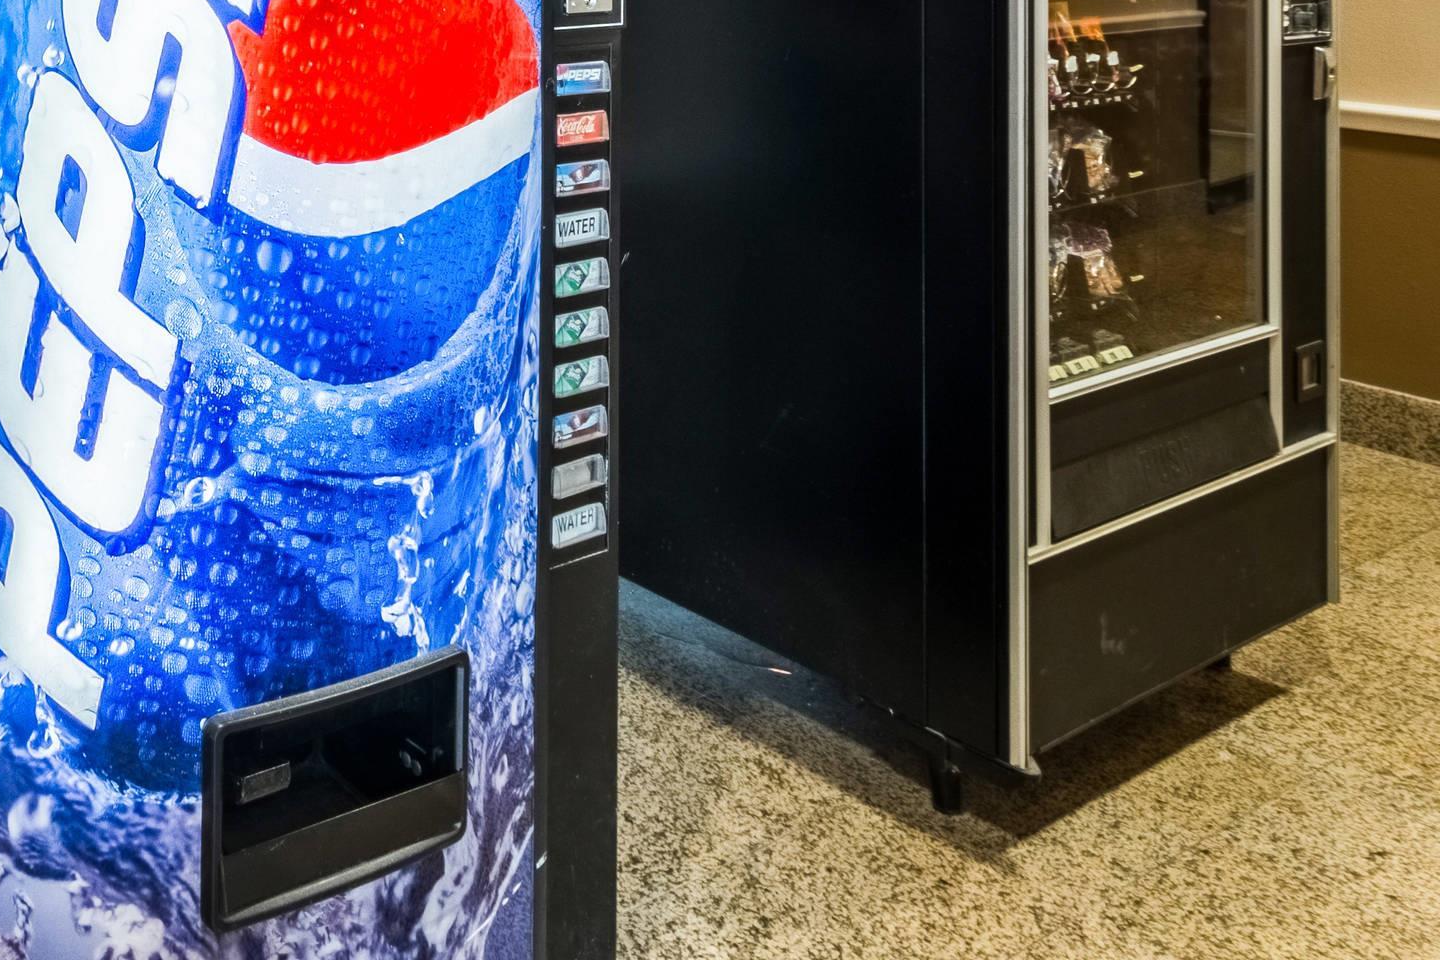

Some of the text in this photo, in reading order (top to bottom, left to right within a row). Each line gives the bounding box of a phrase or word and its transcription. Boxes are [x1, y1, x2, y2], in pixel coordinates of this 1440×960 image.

[567, 68, 601, 82] PEPSI
[557, 216, 595, 238] WATER
[556, 506, 594, 534] WATER
